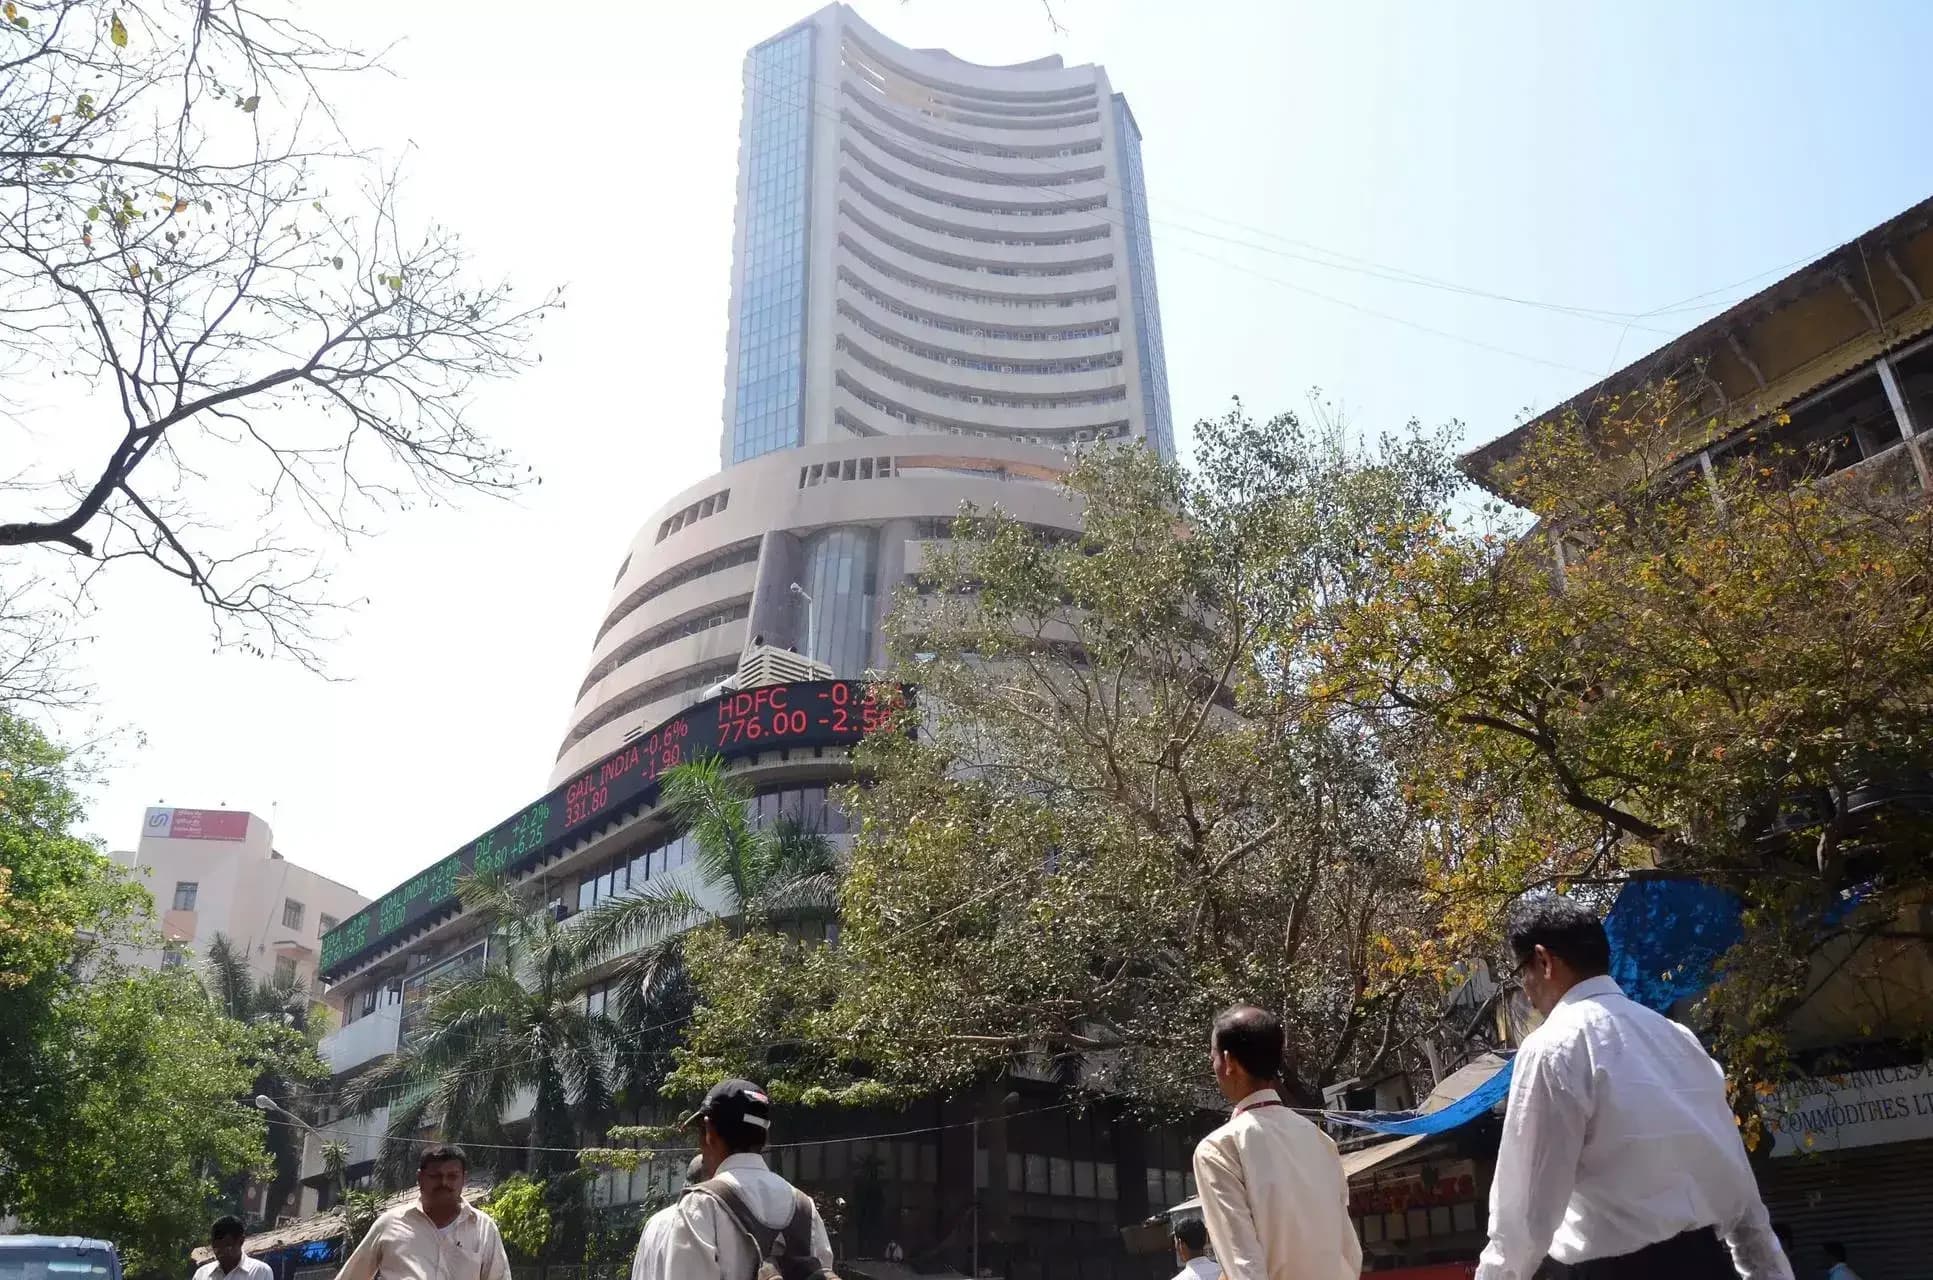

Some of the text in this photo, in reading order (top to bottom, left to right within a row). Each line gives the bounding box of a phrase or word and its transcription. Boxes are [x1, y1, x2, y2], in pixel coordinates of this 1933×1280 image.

[719, 682, 906, 721] HDFC -0.3
[718, 710, 807, 747] 776.00
[566, 719, 688, 804] GAIL INDIA -0.6%
[564, 744, 681, 828] 331.80 -190
[475, 832, 496, 860] DLF
[403, 875, 428, 904] INDIA
[1779, 1096, 1910, 1134] COMMODITIES
